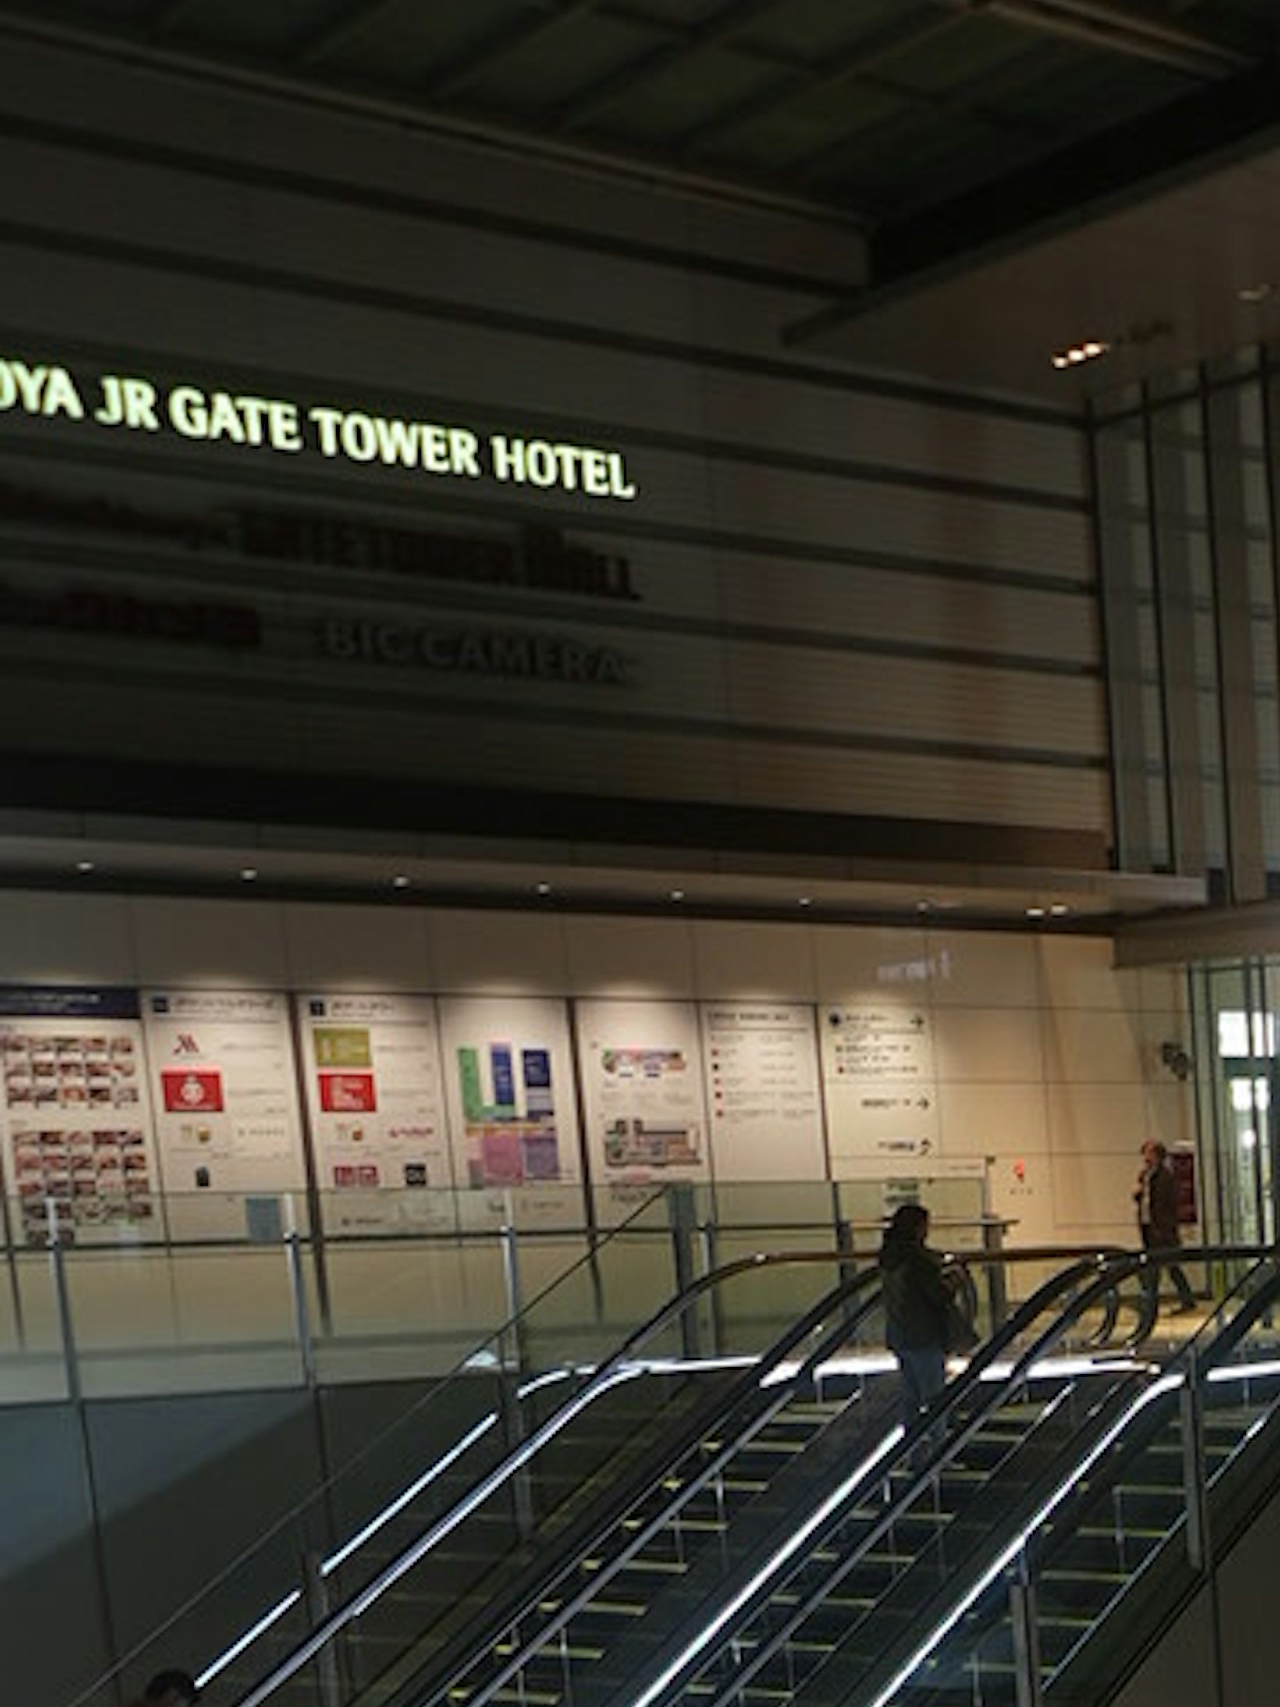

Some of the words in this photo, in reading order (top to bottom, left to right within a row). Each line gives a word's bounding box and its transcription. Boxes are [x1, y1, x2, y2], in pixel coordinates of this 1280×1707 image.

[95, 374, 160, 432] JR
[168, 386, 302, 453] GATE
[308, 407, 481, 478] TOWER
[490, 433, 637, 501] HOTEL
[324, 618, 404, 661] BIC
[420, 629, 628, 685] CAMERA
